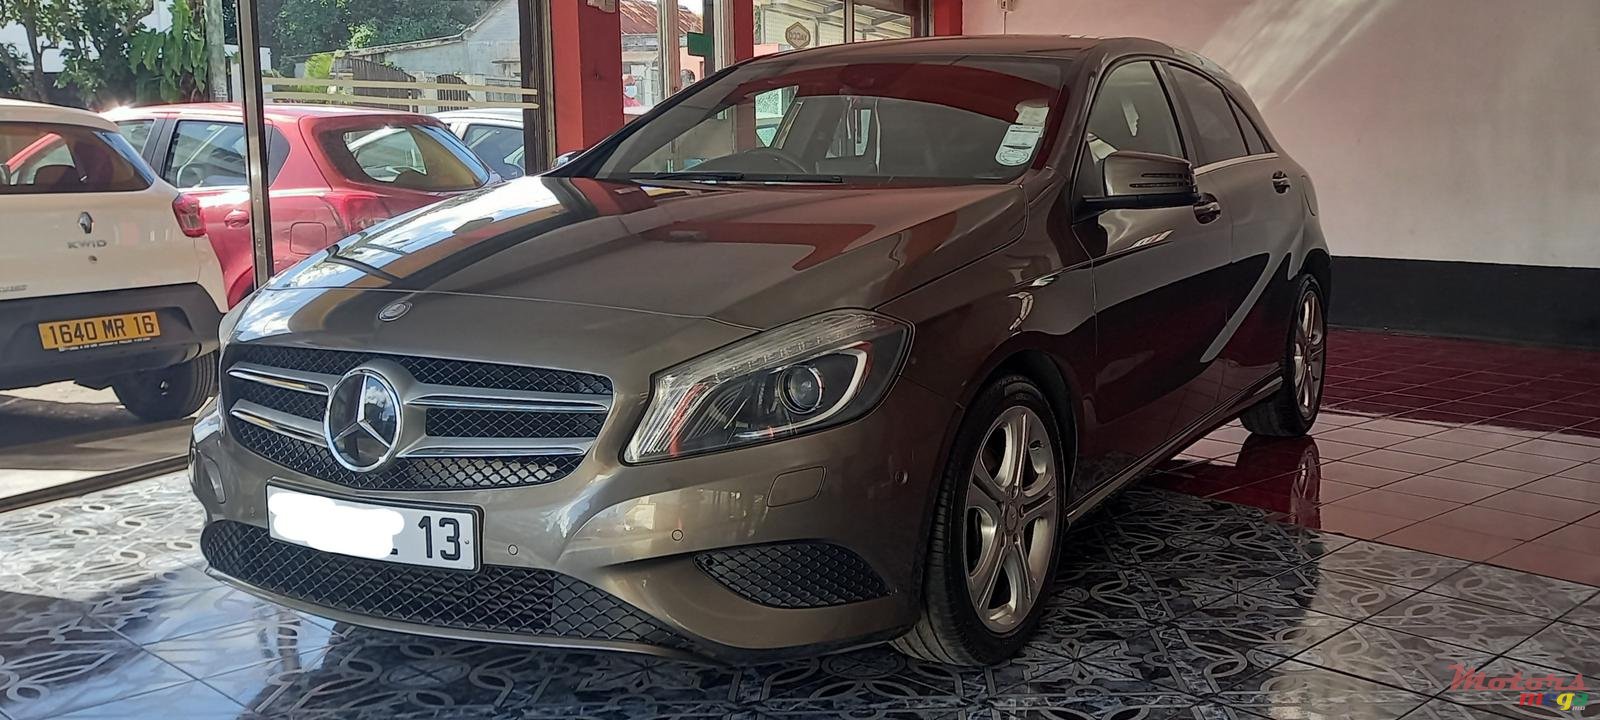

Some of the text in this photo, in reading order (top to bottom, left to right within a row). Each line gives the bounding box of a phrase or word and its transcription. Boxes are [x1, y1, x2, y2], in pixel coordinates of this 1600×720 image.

[67, 240, 107, 249] KWID
[49, 321, 97, 345] 1640
[102, 319, 126, 339] MR
[133, 315, 154, 335] 16
[418, 516, 460, 561] 13
